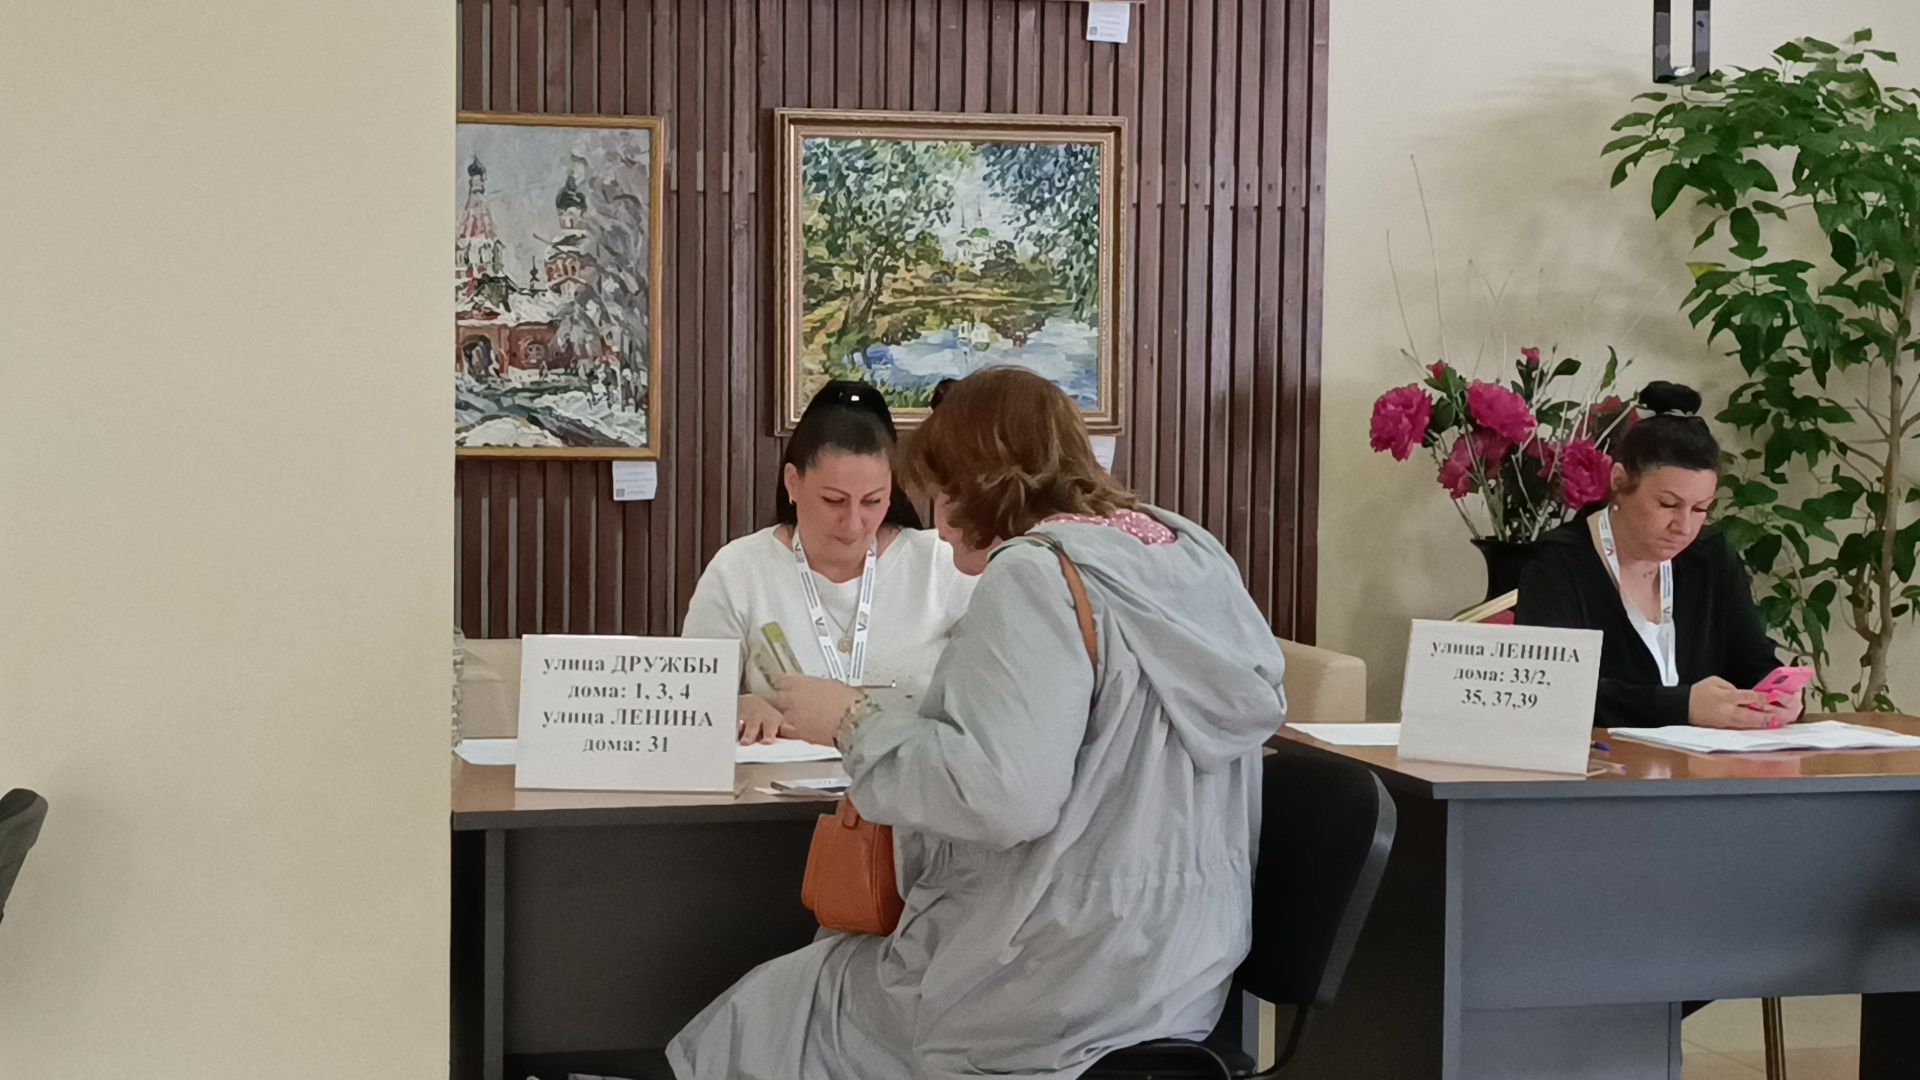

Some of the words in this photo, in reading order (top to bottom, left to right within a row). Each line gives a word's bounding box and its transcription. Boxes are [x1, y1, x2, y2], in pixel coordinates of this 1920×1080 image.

[1430, 641, 1485, 657] улица
[1490, 642, 1580, 663] ЛЕНИНА
[542, 658, 605, 675] улица
[611, 655, 718, 675] ДРУЖБЫ
[1454, 668, 1504, 682] дома:
[1510, 668, 1551, 686] 33/2,
[568, 685, 626, 699] дома:
[636, 683, 650, 700] 1,
[656, 683, 674, 701] 3,
[679, 683, 690, 699] 4
[1461, 689, 1486, 706] 35,
[542, 711, 604, 728] улица
[611, 708, 713, 727] ЛЕНИНА
[582, 738, 640, 752] дома:
[648, 736, 668, 752] 31
